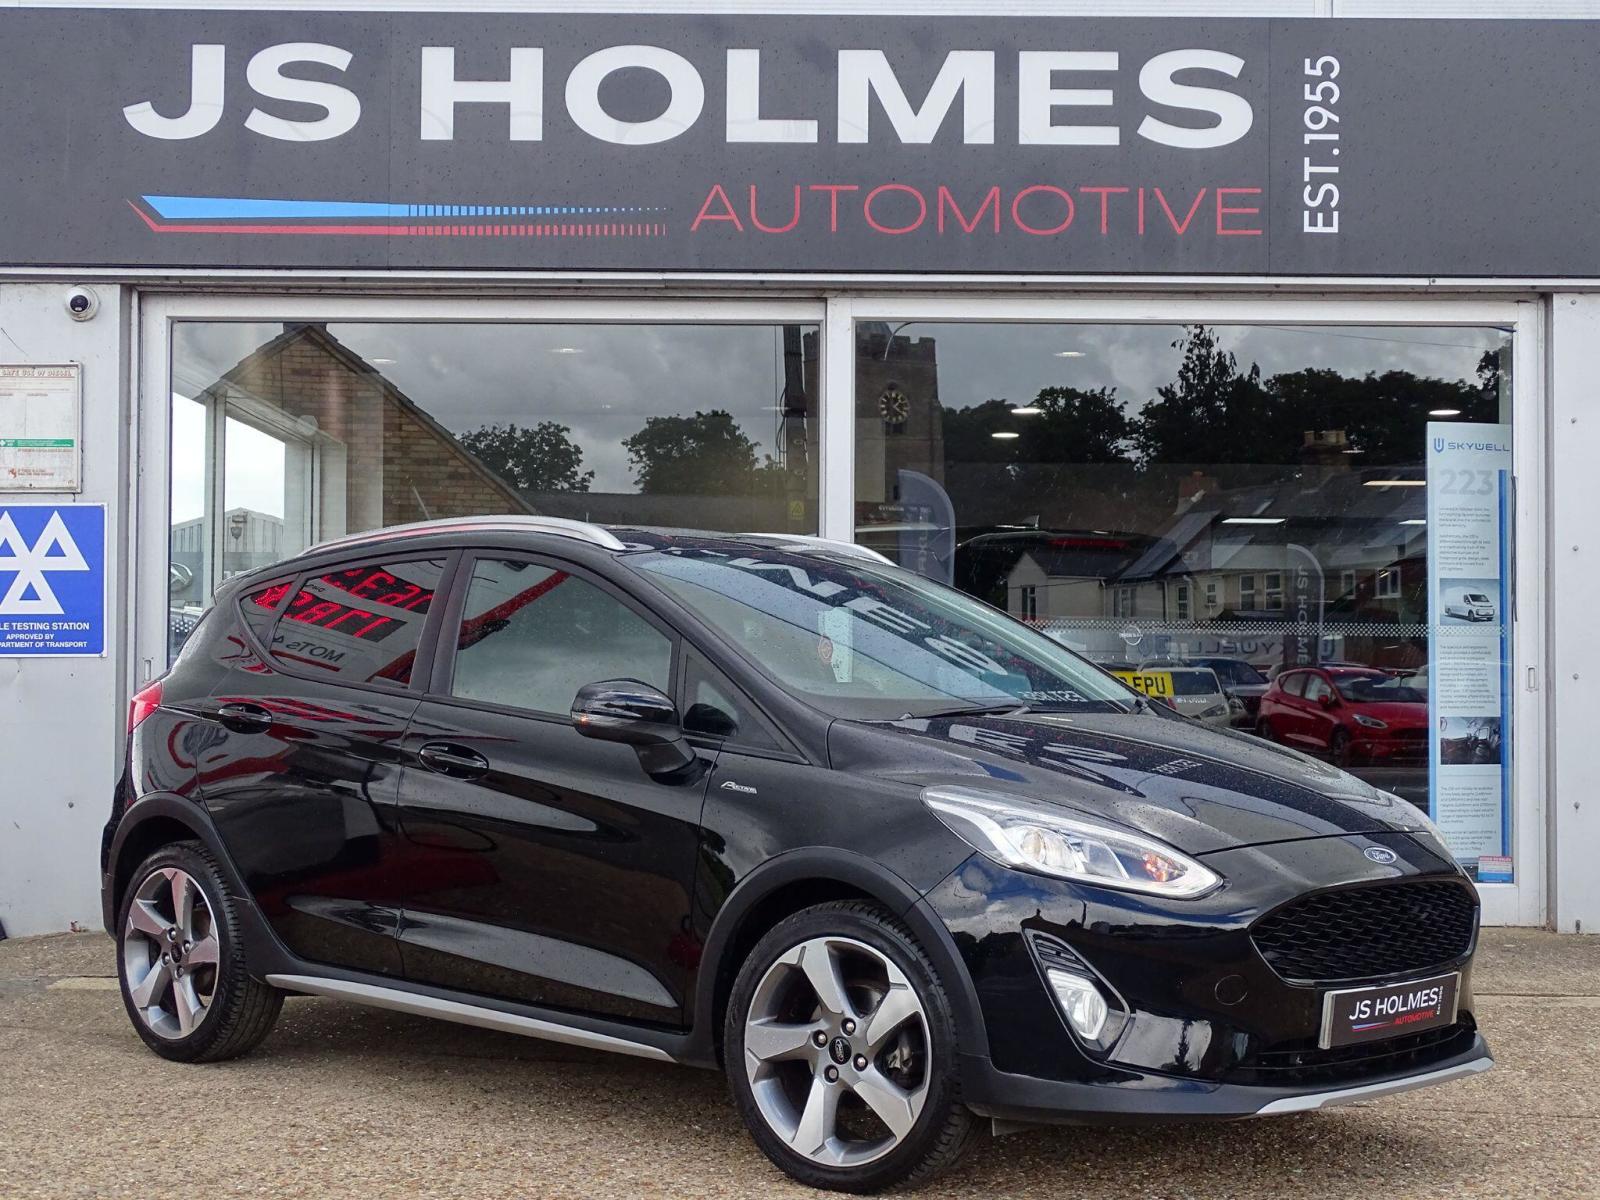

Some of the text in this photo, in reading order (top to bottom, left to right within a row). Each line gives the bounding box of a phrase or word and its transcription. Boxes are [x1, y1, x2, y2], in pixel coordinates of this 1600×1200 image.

[122, 42, 1254, 149] JS HOLMES
[1303, 55, 1341, 234] EST.1955
[690, 184, 1263, 236] AUTOMOTIVE
[1447, 441, 1510, 452] SKYWELL
[1439, 468, 1494, 496] 223
[11, 622, 50, 630] TESTING
[52, 622, 90, 630] STATION
[1348, 987, 1440, 1021] JS HOLMES
[1393, 1009, 1436, 1025] AUTOMOTIVE
